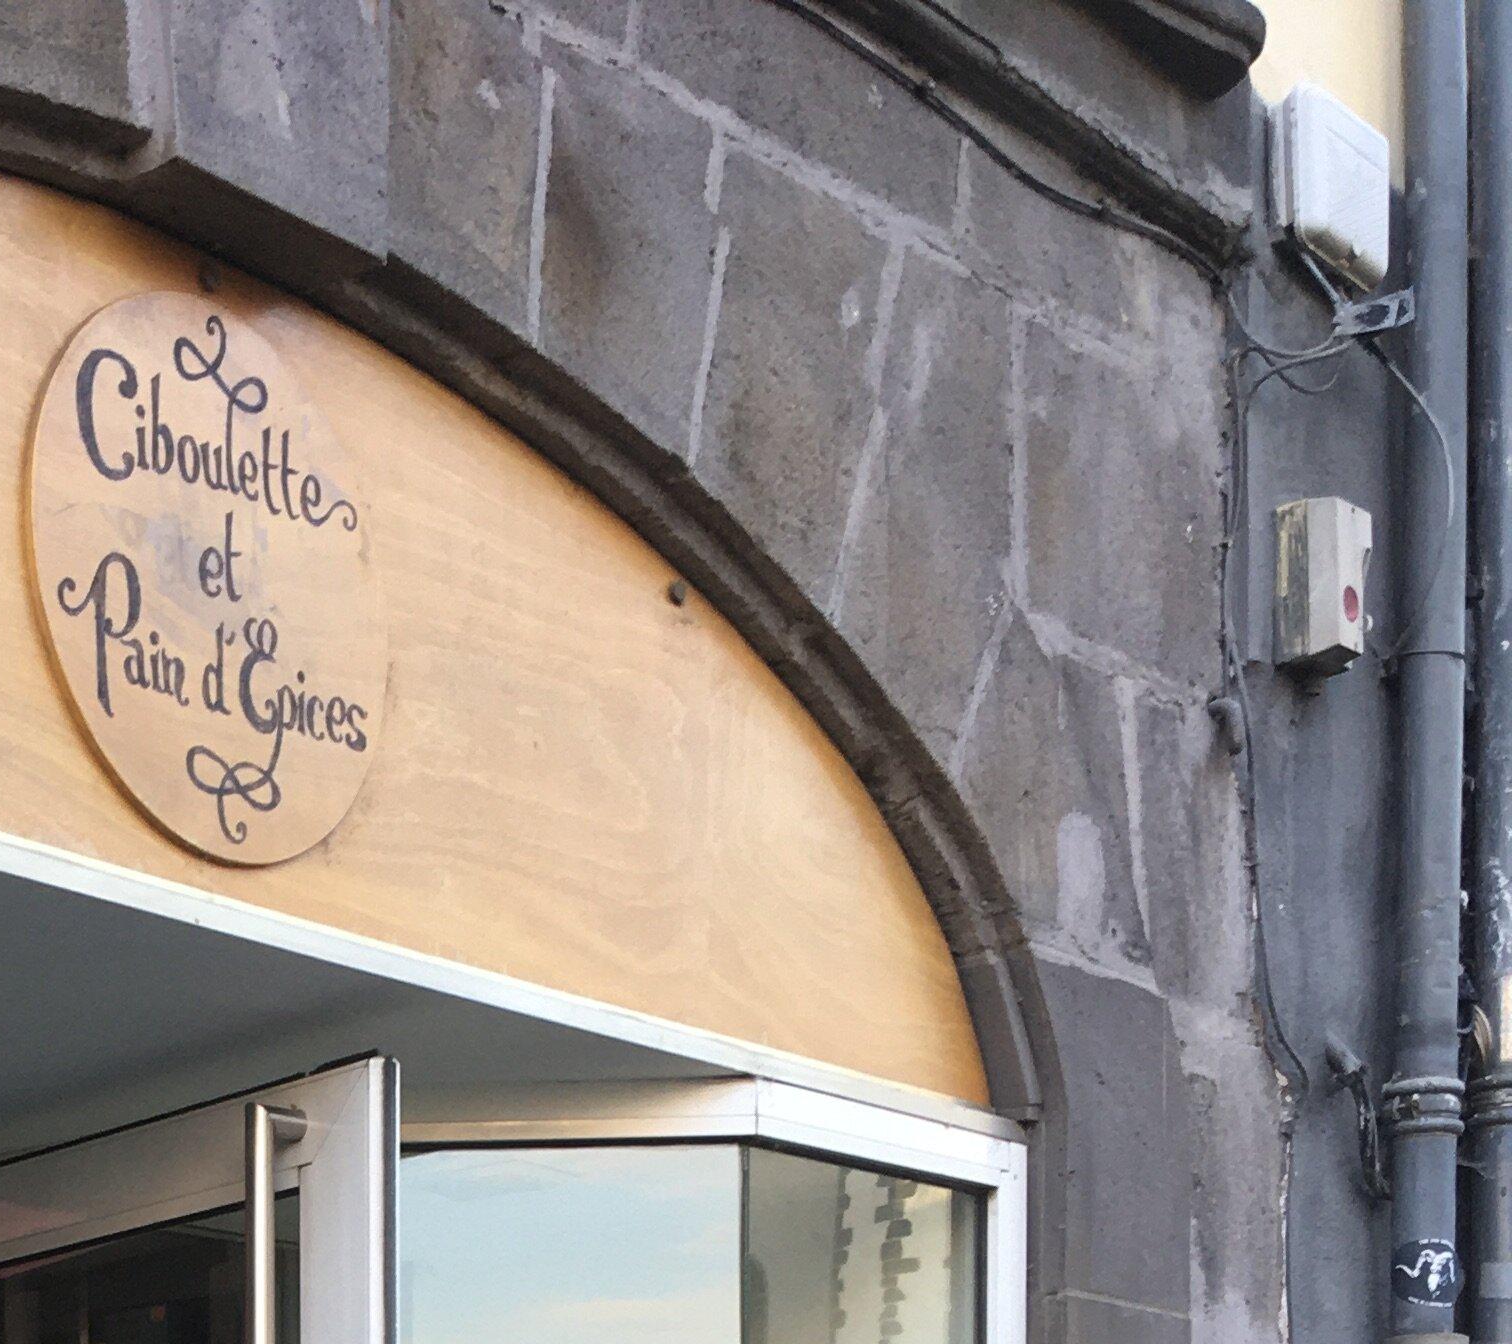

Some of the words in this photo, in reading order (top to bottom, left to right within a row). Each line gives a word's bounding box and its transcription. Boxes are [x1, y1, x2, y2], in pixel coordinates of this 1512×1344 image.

[76, 316, 357, 530] Ciboulette
[58, 552, 188, 717] Pain
[199, 512, 241, 601] et
